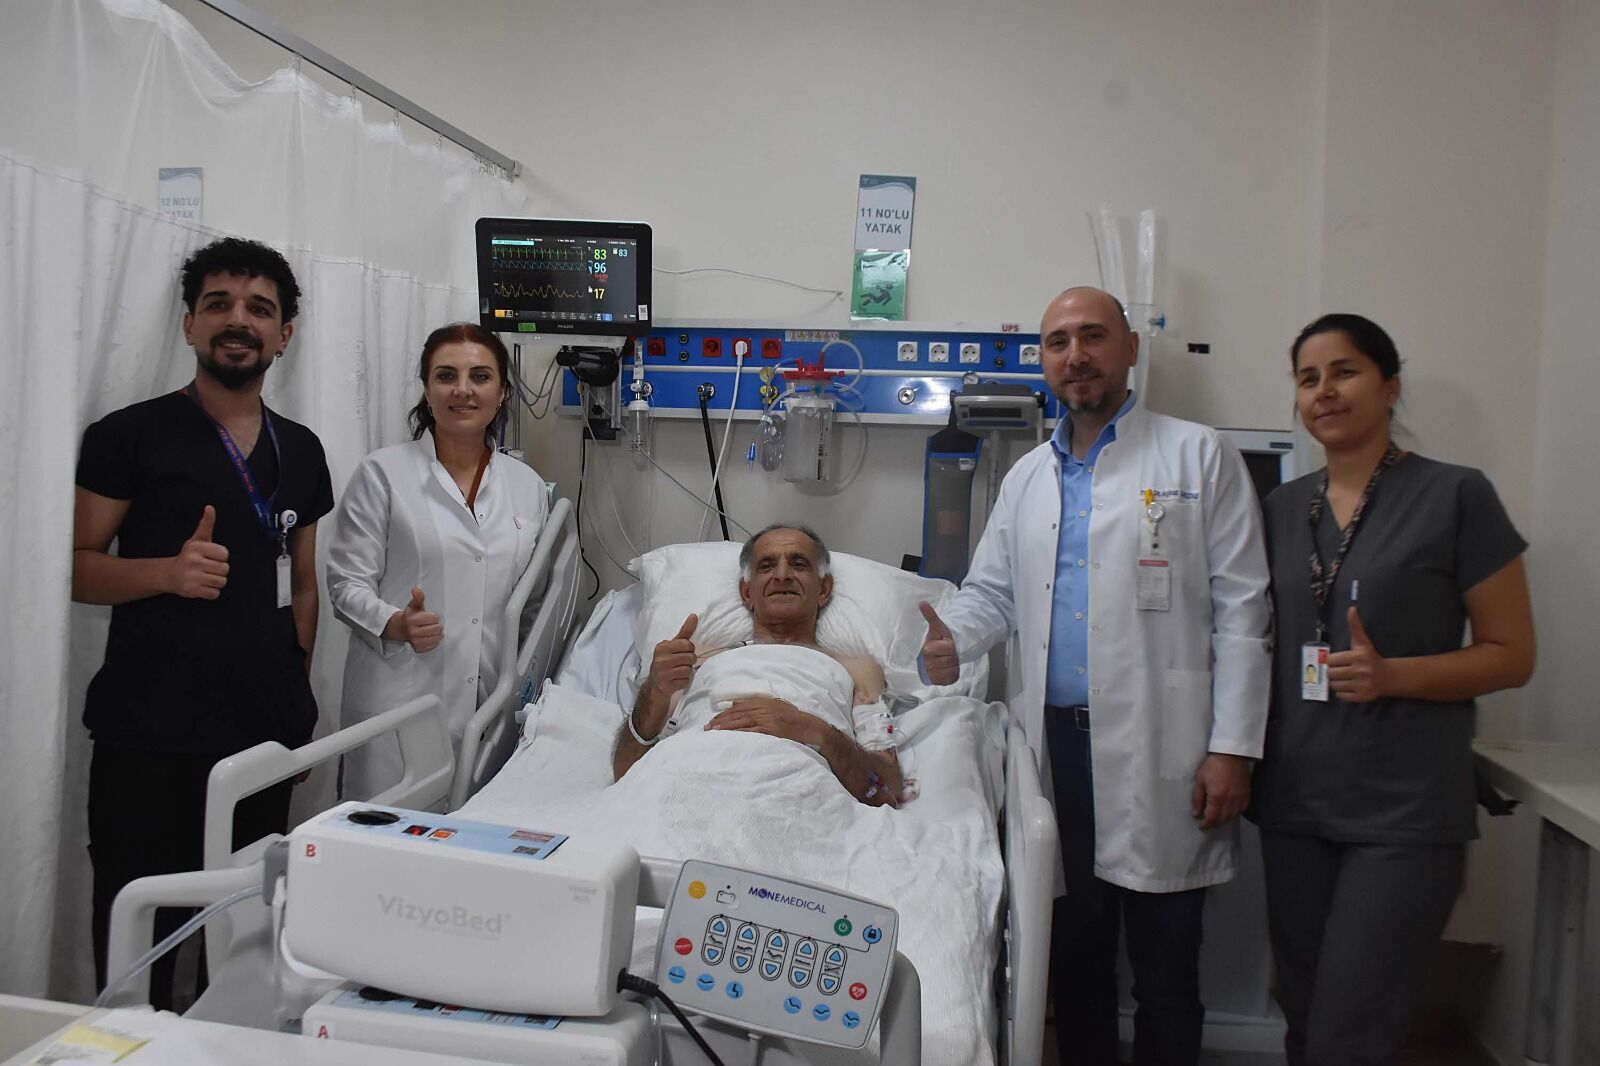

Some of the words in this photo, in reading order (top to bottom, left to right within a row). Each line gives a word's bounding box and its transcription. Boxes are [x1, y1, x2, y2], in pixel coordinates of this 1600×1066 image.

[860, 207, 871, 217] 11
[875, 208, 910, 220] NO'LU
[864, 223, 902, 235] YATAK
[593, 248, 607, 261] 83
[618, 248, 628, 257] 83
[593, 261, 607, 274] 96
[593, 288, 605, 300] 17
[1001, 324, 1020, 333] UPS
[304, 843, 317, 858] B
[748, 886, 827, 914] MONEMEDICAL
[376, 893, 503, 935] VizyoBed
[316, 1024, 330, 1040] A
